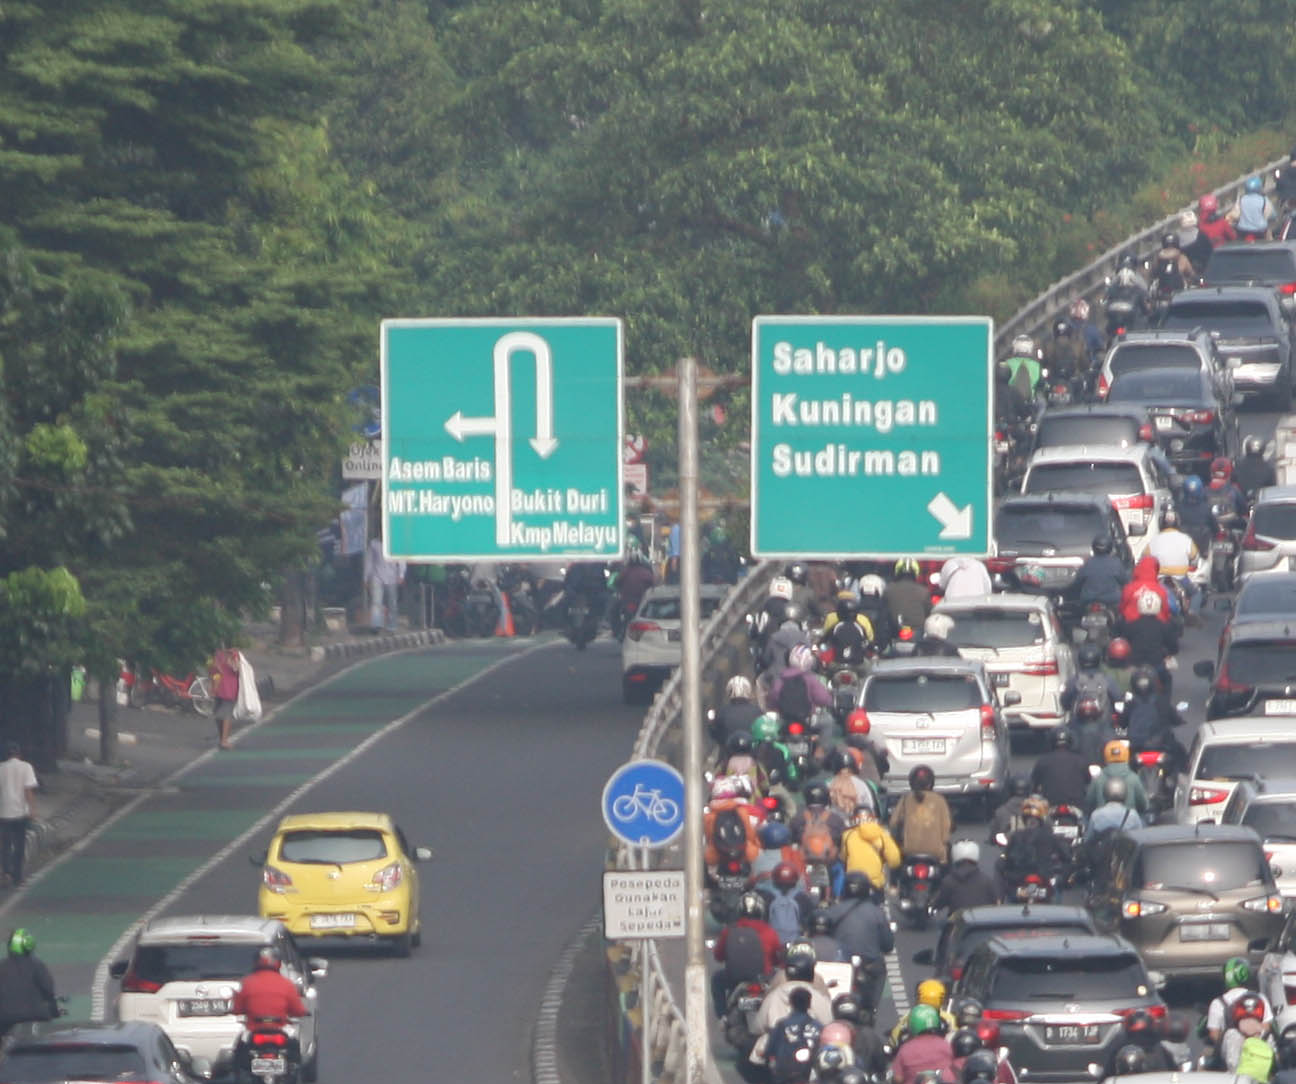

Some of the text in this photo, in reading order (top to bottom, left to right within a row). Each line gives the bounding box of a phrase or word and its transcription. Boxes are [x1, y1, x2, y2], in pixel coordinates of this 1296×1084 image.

[773, 341, 906, 379] Saharjo
[772, 393, 937, 433] Kuningan
[389, 457, 491, 480] Asem Baris
[772, 443, 940, 477] Sudirman
[512, 489, 608, 512] Bukit Duri
[554, 522, 617, 549] Melayu
